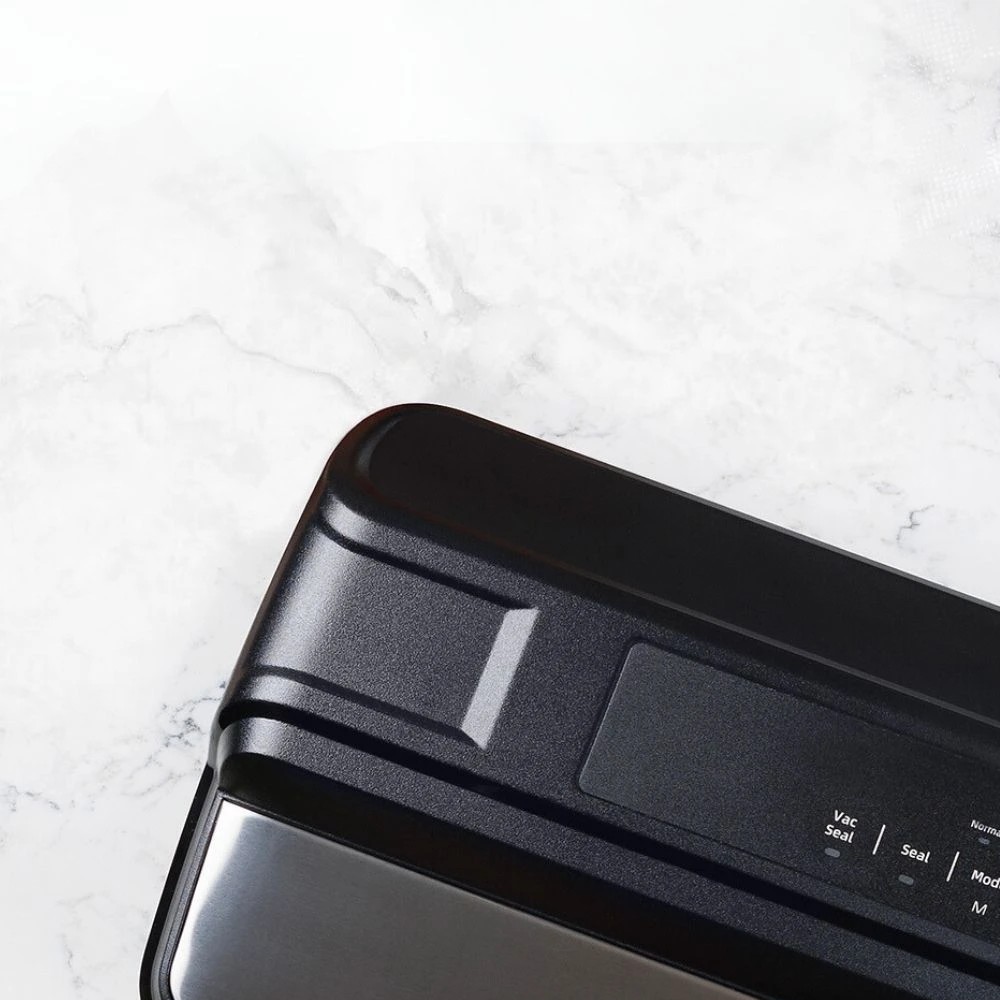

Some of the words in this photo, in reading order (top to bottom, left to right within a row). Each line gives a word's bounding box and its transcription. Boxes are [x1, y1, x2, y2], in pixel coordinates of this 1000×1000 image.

[833, 809, 858, 828] Vac
[824, 823, 855, 843] Seal
[900, 844, 930, 864] Seal
[971, 900, 988, 916] M
